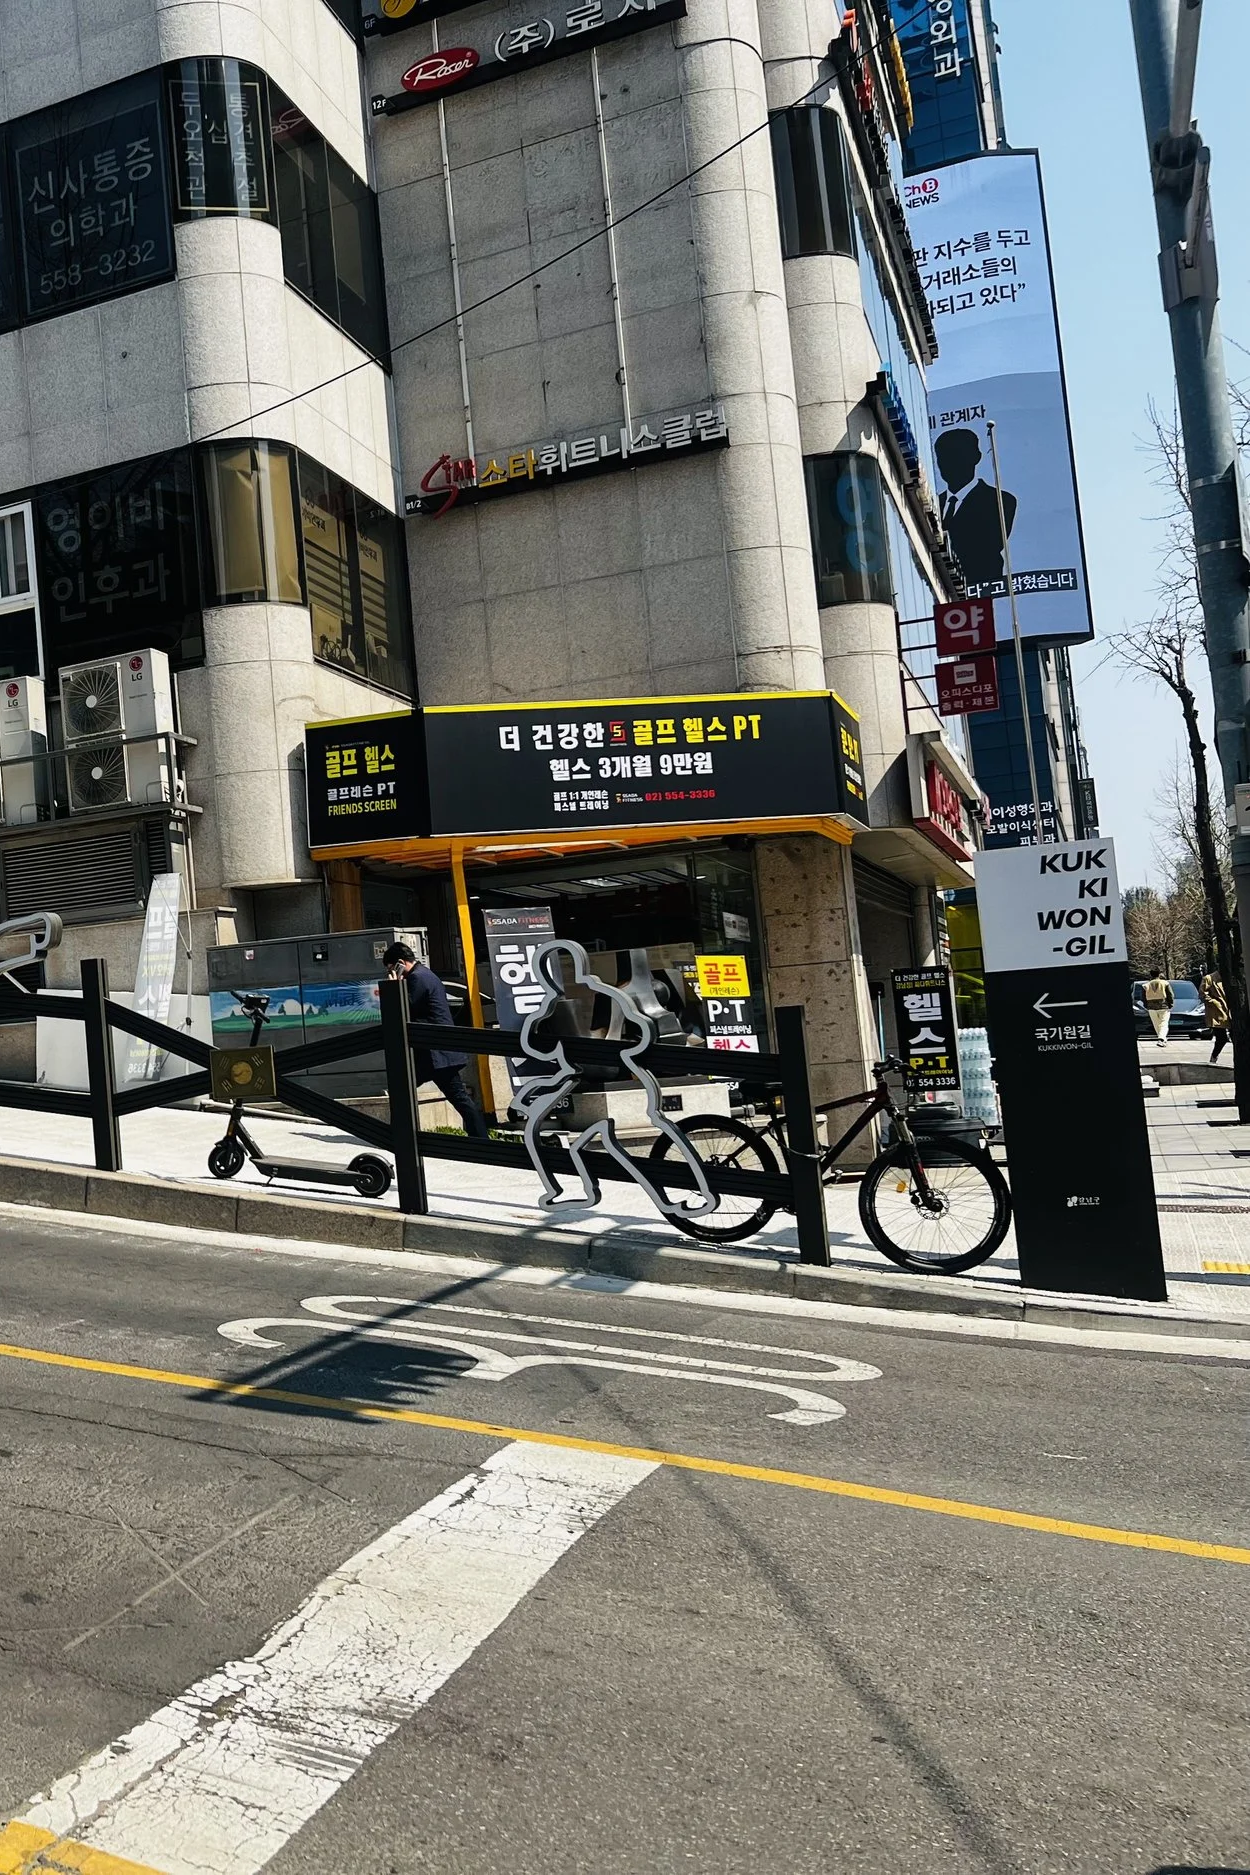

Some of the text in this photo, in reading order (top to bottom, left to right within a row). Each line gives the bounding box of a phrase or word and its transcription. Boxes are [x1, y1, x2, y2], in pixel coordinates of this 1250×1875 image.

[364, 18, 376, 29] 6F
[403, 57, 473, 87] Roser
[372, 99, 387, 110] 12F
[27, 137, 153, 215] 신사통증
[49, 192, 139, 248] 의학과
[933, 231, 992, 261] 지수를
[996, 229, 1031, 249] 두고
[39, 239, 156, 294] 558-3232
[923, 256, 1017, 291] 거래소들의
[940, 405, 986, 427] 관계자
[943, 607, 985, 646] 약
[131, 672, 143, 682] LG
[941, 684, 994, 699] 오피스디포
[7, 699, 19, 708] LG
[498, 726, 521, 752] 더
[531, 721, 605, 751] 건강한
[632, 719, 677, 746] 골프
[682, 717, 728, 744] 헬스
[732, 714, 761, 740] PT
[325, 744, 396, 779] 골프 헬스
[549, 751, 714, 782] 헬스 3개월 9만원
[327, 781, 396, 801] 골프레슨 PT
[664, 789, 716, 801] 554-3336
[327, 798, 397, 817] FRIENDS SCREEN
[1039, 847, 1107, 875] KUK
[1078, 876, 1109, 899] KI
[1037, 905, 1112, 932] WON
[1052, 935, 1116, 958] -GIL
[704, 963, 742, 985] 골프
[903, 992, 947, 1055] 헬스
[1034, 1025, 1092, 1041] 국기원길
[1037, 1042, 1094, 1052] KUKKIWON-GIL
[918, 1078, 934, 1087] 554
[936, 1076, 956, 1086] 3336
